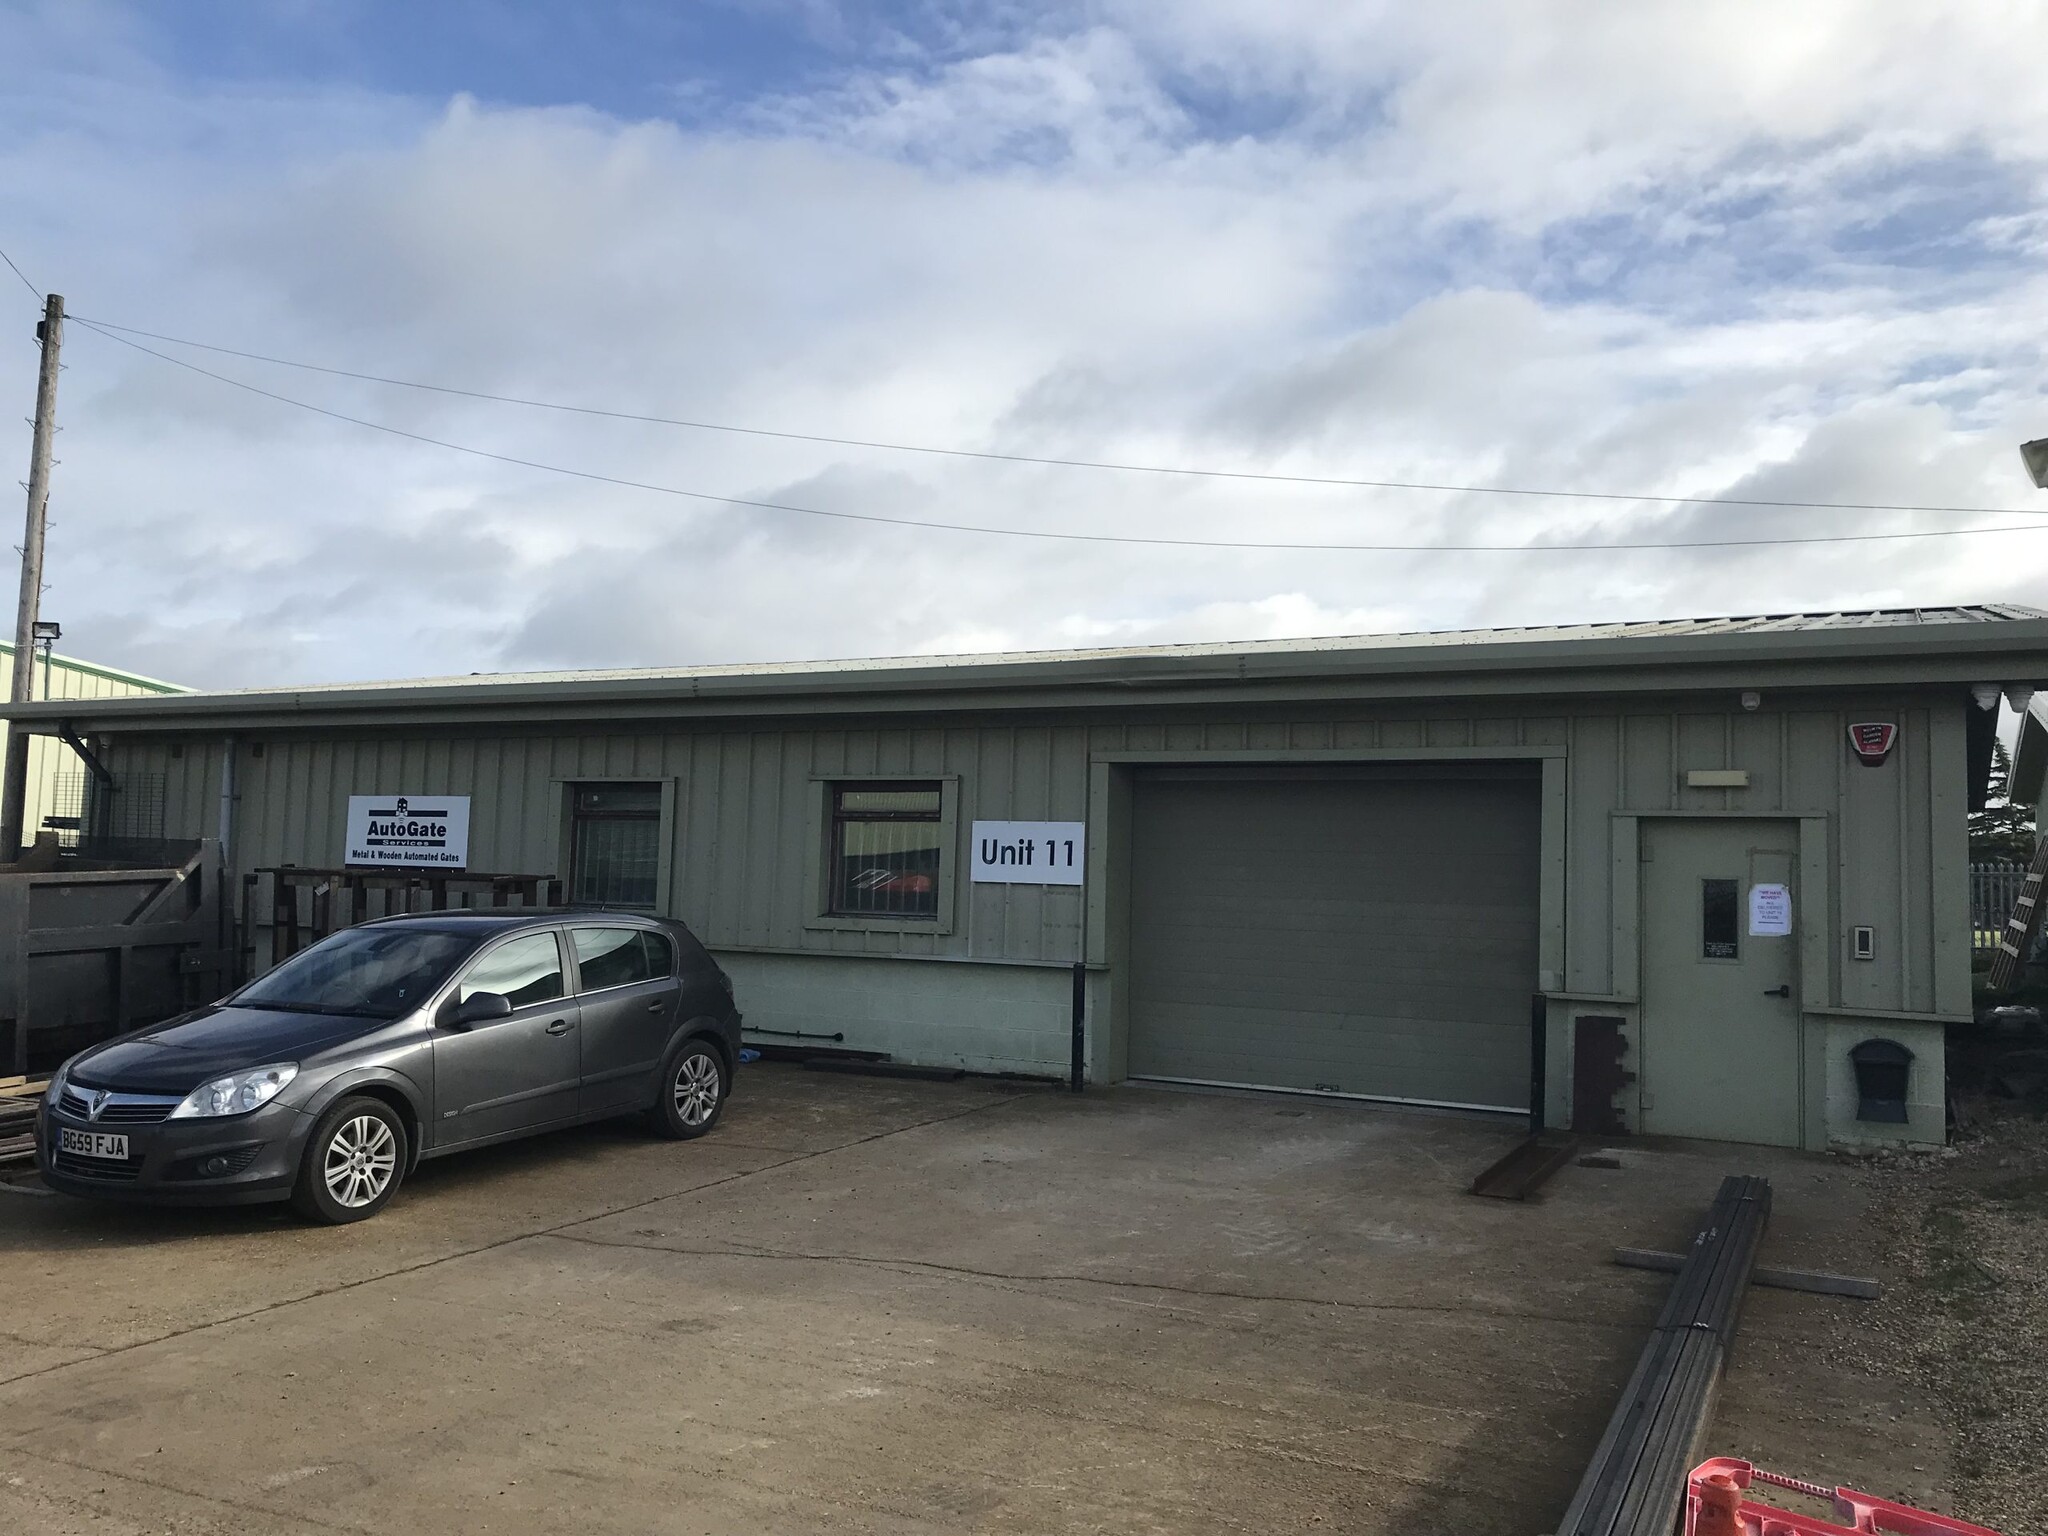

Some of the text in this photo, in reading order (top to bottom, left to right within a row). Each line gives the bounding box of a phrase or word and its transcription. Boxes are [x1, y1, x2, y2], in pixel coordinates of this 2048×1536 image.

[367, 820, 447, 837] AutoGate
[382, 839, 430, 847] Services
[352, 849, 459, 862] Metal & Wooden Automated Gates
[981, 838, 1073, 866] Unit 11
[62, 1130, 124, 1156] BG59 FJA
